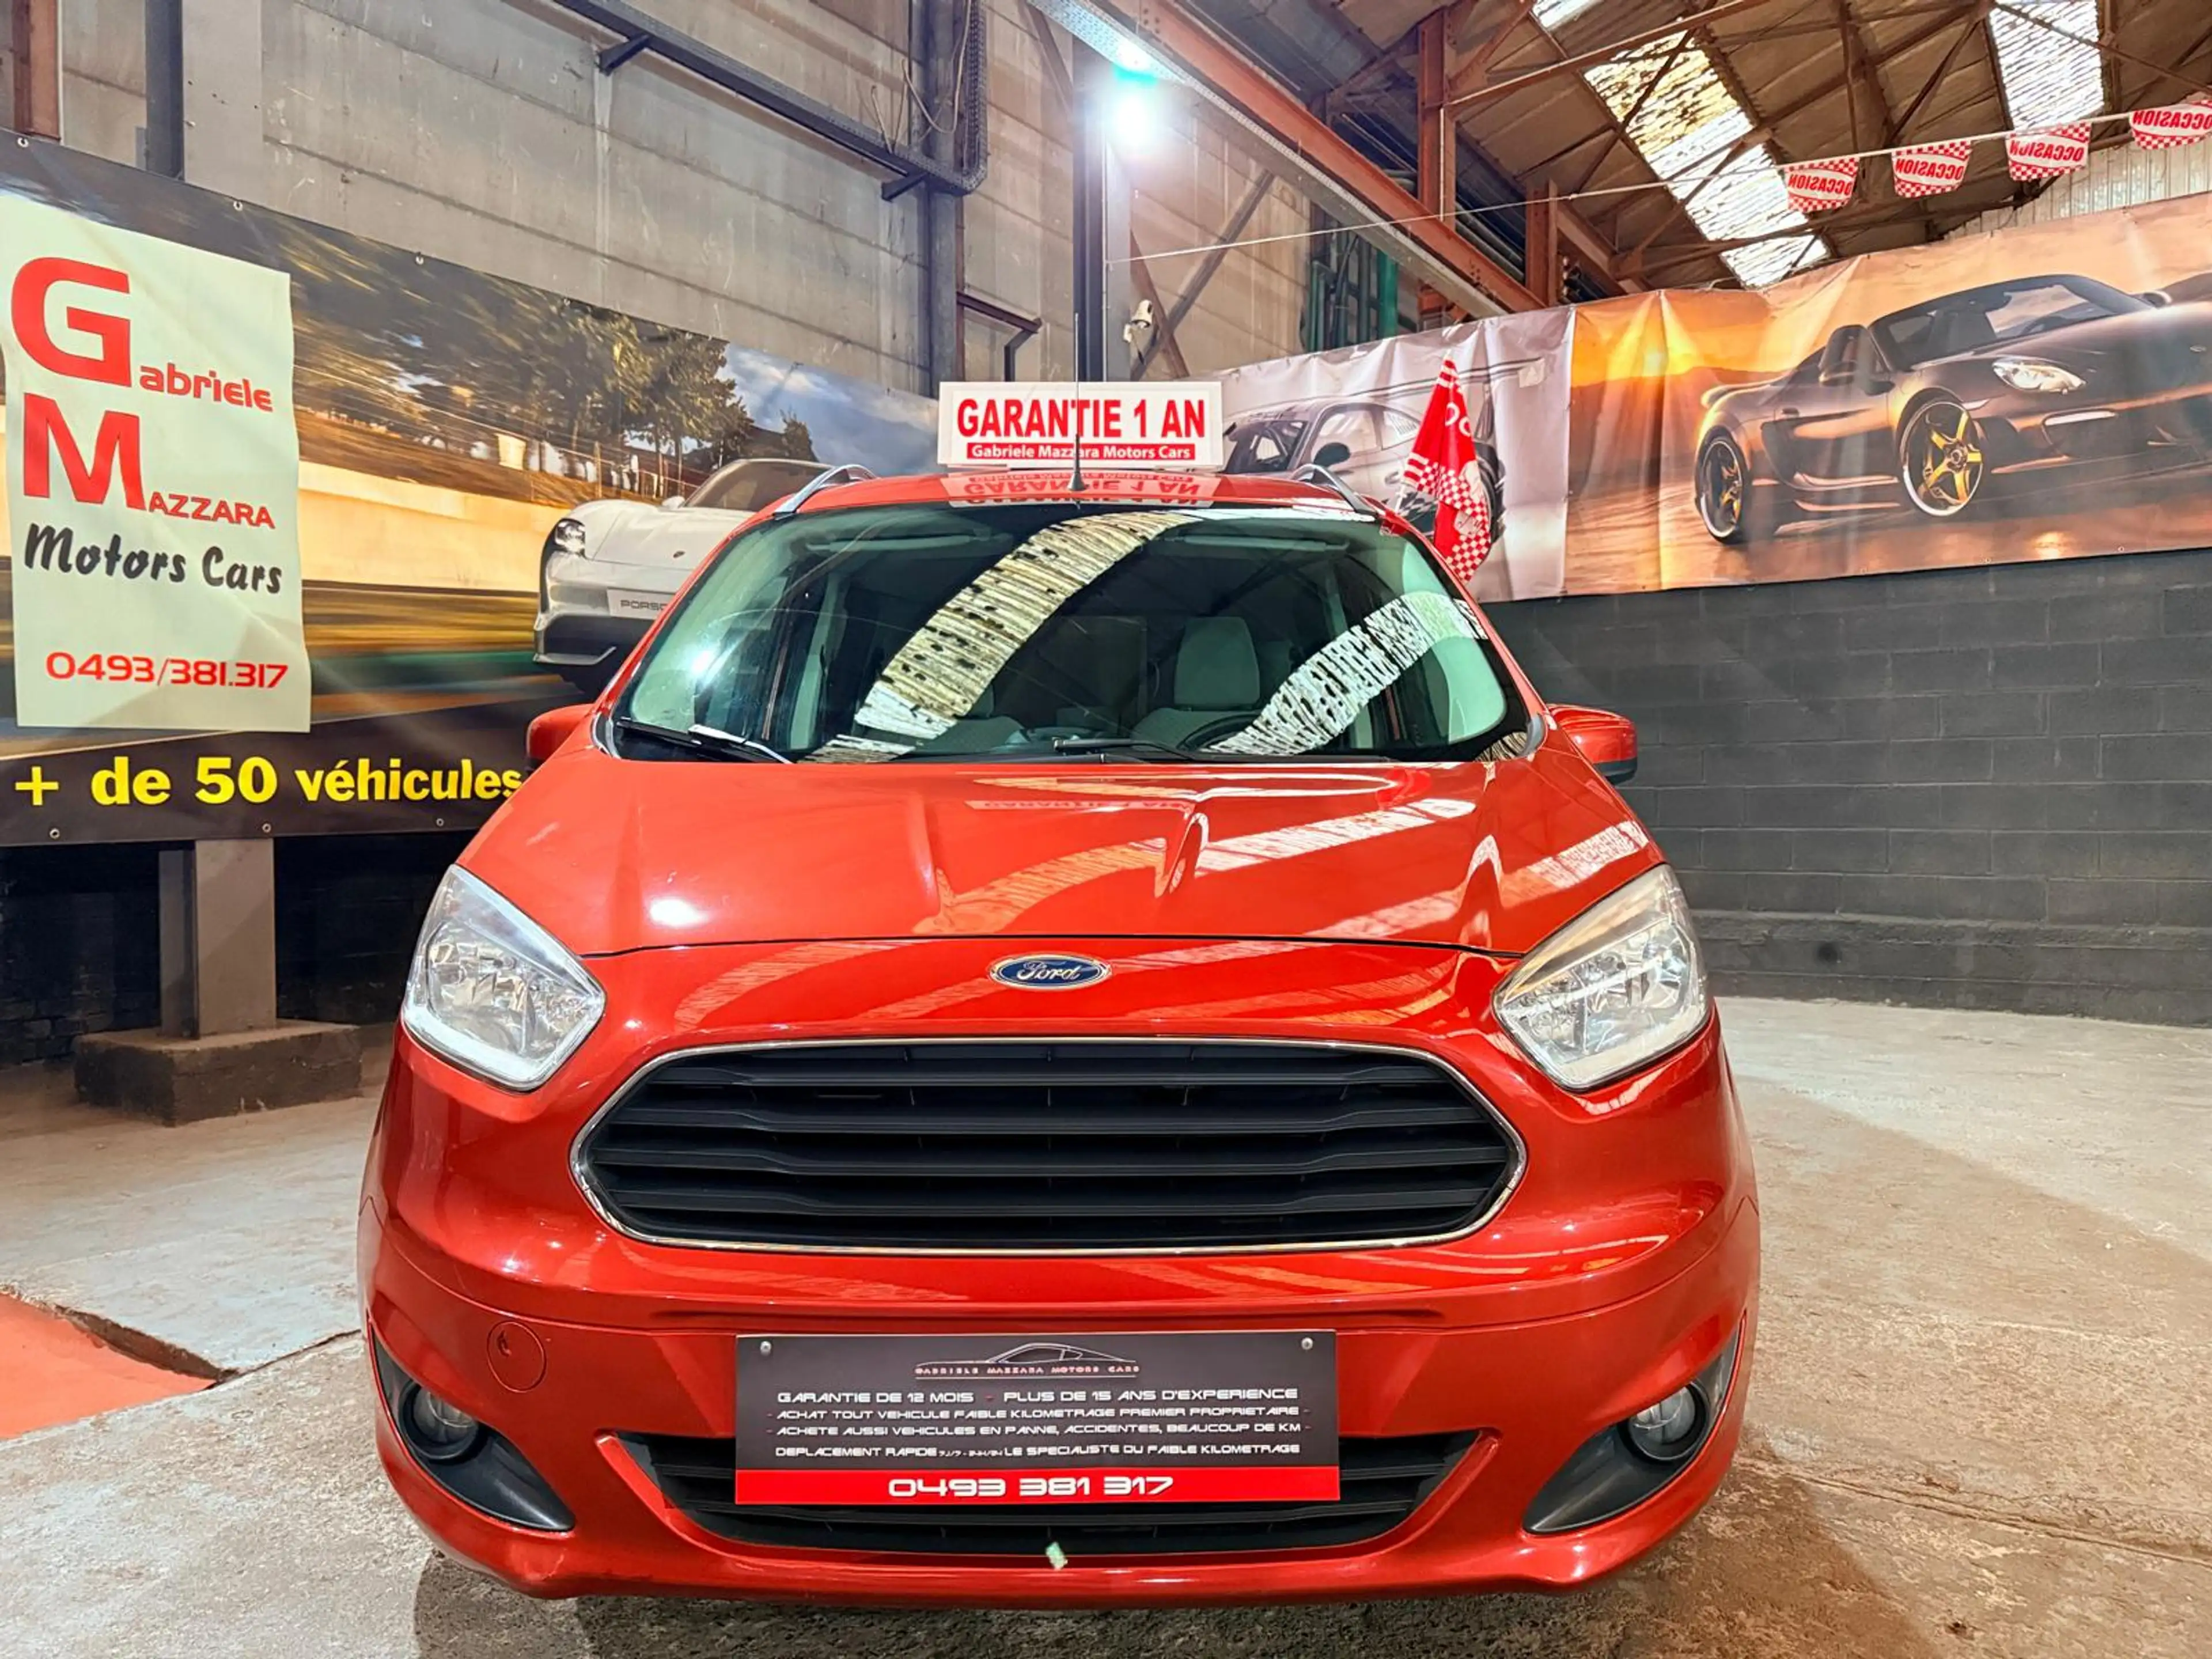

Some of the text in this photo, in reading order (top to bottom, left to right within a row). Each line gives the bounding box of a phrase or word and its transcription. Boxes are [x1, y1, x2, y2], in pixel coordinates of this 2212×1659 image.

[957, 399, 1205, 438] GARANTIE 1 AN
[24, 393, 275, 528] MAZZARA
[972, 445, 1190, 459] Gabriele Mazzara Motors Cars
[25, 524, 281, 593] Motors Cars
[46, 652, 288, 687] 0493/381.317
[92, 757, 170, 805] de
[195, 757, 277, 803] 50
[294, 759, 522, 801] véhicules
[1017, 961, 1082, 980] Ford
[777, 1392, 871, 1403] GARANTIE
[876, 1392, 902, 1403] DE
[907, 1392, 925, 1403] 12
[929, 1392, 974, 1403] MOIS
[1003, 1391, 1055, 1402] PLUS
[1060, 1391, 1086, 1402] DE
[1092, 1391, 1112, 1401] 15
[1117, 1390, 1157, 1401] ANS
[1161, 1388, 1298, 1400] D'EXPERIENCE
[777, 1410, 828, 1419] ACHAT
[831, 1410, 874, 1419] TOUT
[877, 1410, 950, 1419] VEHICULE
[953, 1410, 1007, 1419] FAIBLE
[1010, 1408, 1115, 1418] KILOMETRAGE
[1119, 1407, 1186, 1416] PREMIER
[1189, 1406, 1299, 1416] PROPRIETAIRE
[777, 1426, 838, 1435] ACHETE
[842, 1426, 888, 1435] AUSSI
[892, 1426, 976, 1435] VEHICULES
[979, 1426, 1002, 1435] EN
[1005, 1425, 1060, 1435] PANNE,
[1166, 1423, 1250, 1433] BEAUCOUP
[1254, 1423, 1275, 1432] DE
[1278, 1423, 1301, 1432] KM
[775, 1447, 882, 1457] DEPLACEMENT
[885, 1447, 937, 1457] RAPIDE
[1004, 1447, 1022, 1456] LE
[1026, 1444, 1120, 1456] SPECIALISTE
[1123, 1445, 1143, 1454] DU
[1147, 1445, 1197, 1454] FAIBLE
[1200, 1444, 1300, 1454] KILOMETRAGE
[889, 1476, 1173, 1497] 0493 381 317
